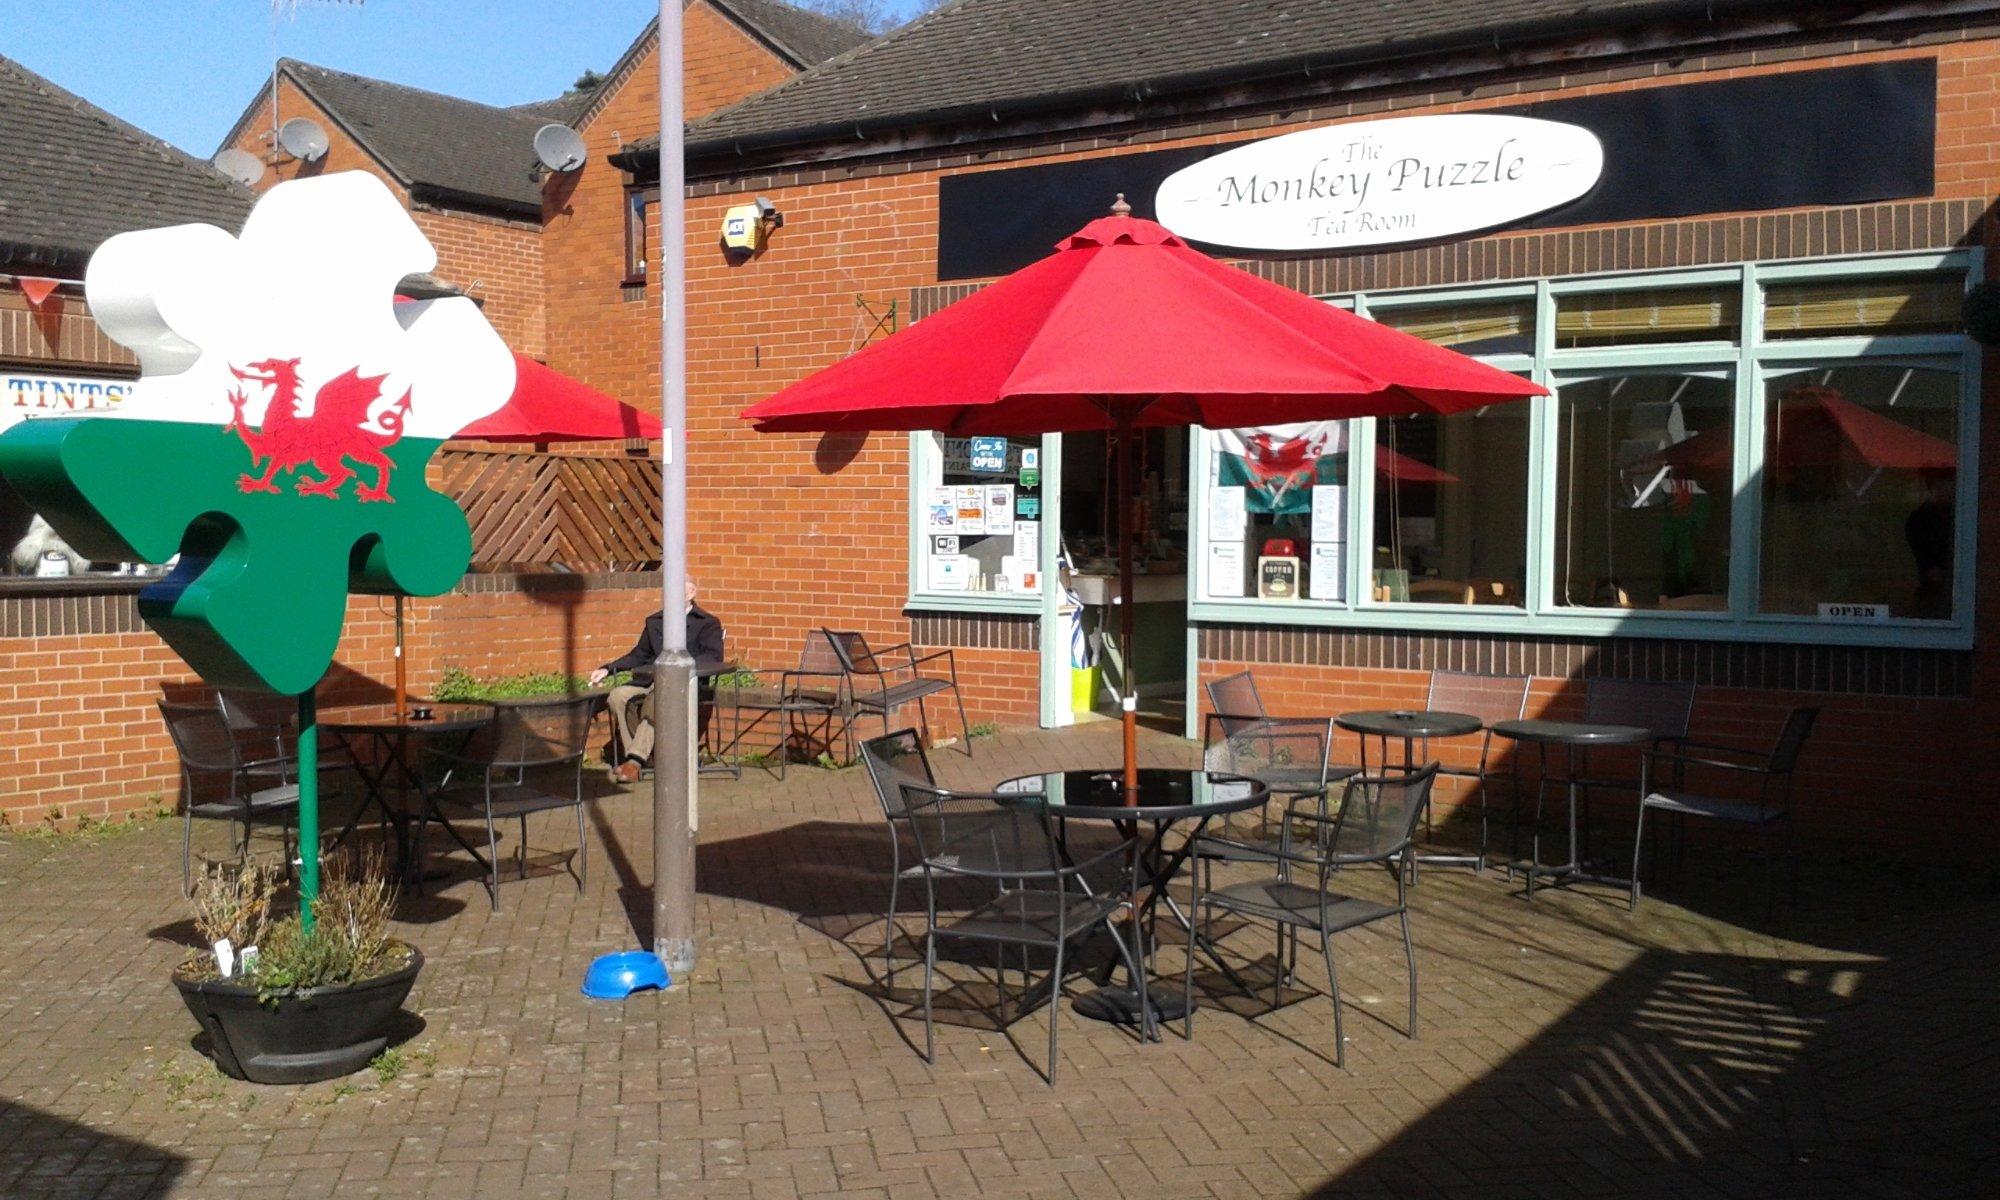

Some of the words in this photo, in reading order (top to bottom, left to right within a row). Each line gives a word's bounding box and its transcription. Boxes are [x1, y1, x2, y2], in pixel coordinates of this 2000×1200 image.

[1341, 136, 1383, 163] The
[1217, 157, 1371, 215] Monkey
[1387, 137, 1525, 192] Puzzle
[1308, 211, 1347, 236] Tea
[1355, 211, 1416, 233] Room
[972, 456, 1003, 469] OPEN
[1829, 606, 1875, 617] OPEN
